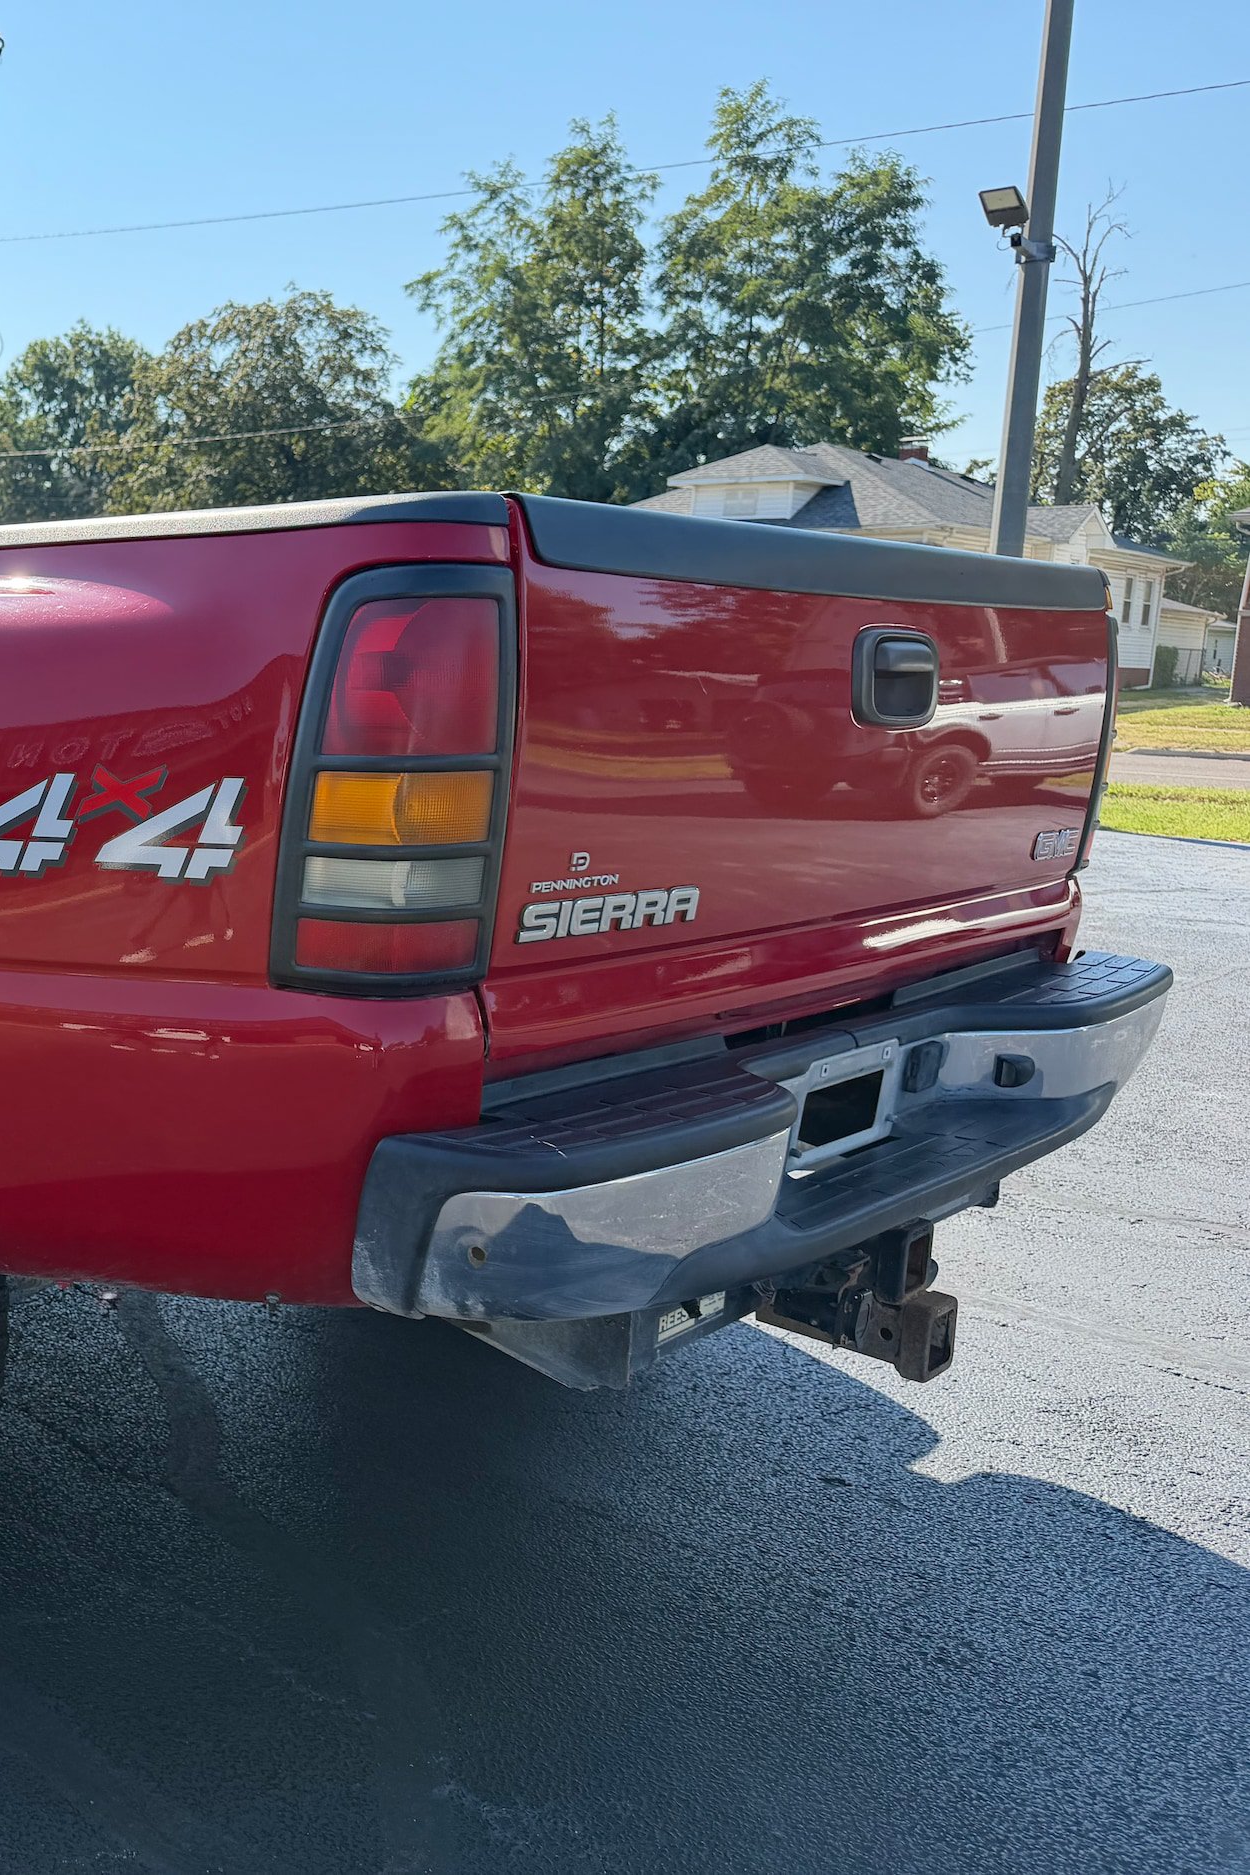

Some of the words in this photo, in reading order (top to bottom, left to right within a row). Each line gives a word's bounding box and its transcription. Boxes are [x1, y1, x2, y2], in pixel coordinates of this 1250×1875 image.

[1031, 827, 1080, 861] GMC
[530, 873, 620, 894] PENNINGTON
[515, 884, 700, 944] SIERRA
